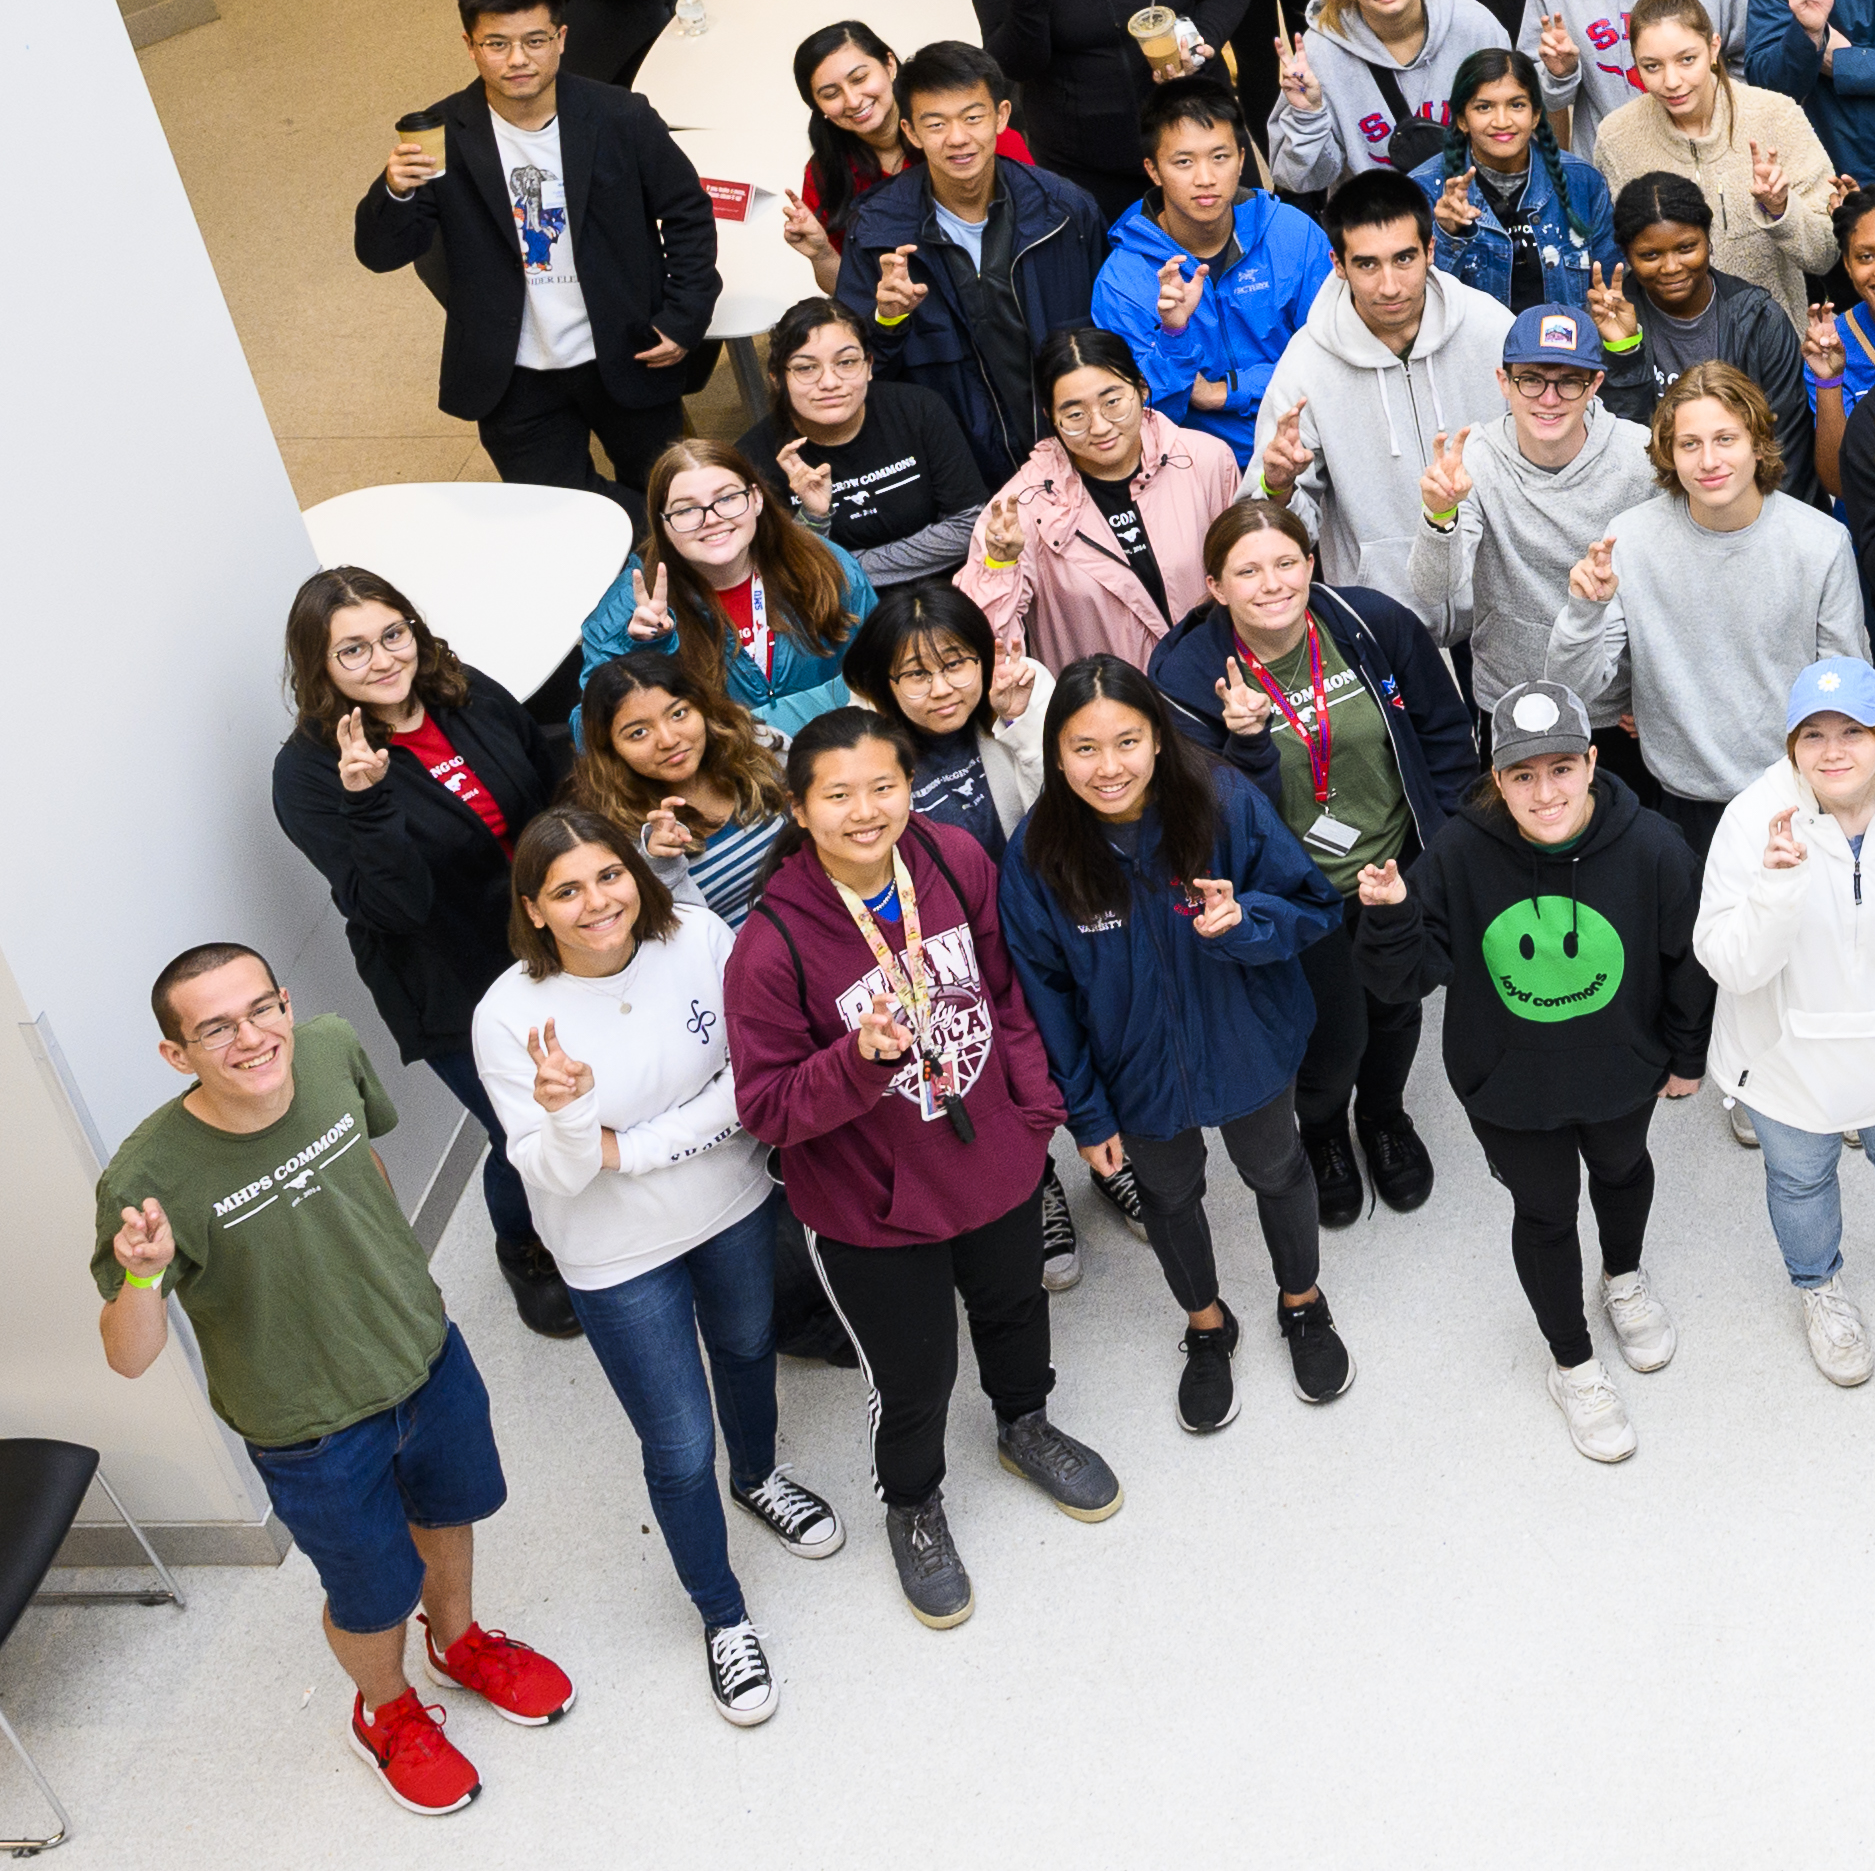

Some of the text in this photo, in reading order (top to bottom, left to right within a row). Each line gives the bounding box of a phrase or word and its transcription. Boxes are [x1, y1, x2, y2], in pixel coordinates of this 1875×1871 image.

[859, 455, 917, 486] COMMONS
[1532, 972, 1608, 1008] commons
[212, 1113, 355, 1217] MHPS COMMONS
